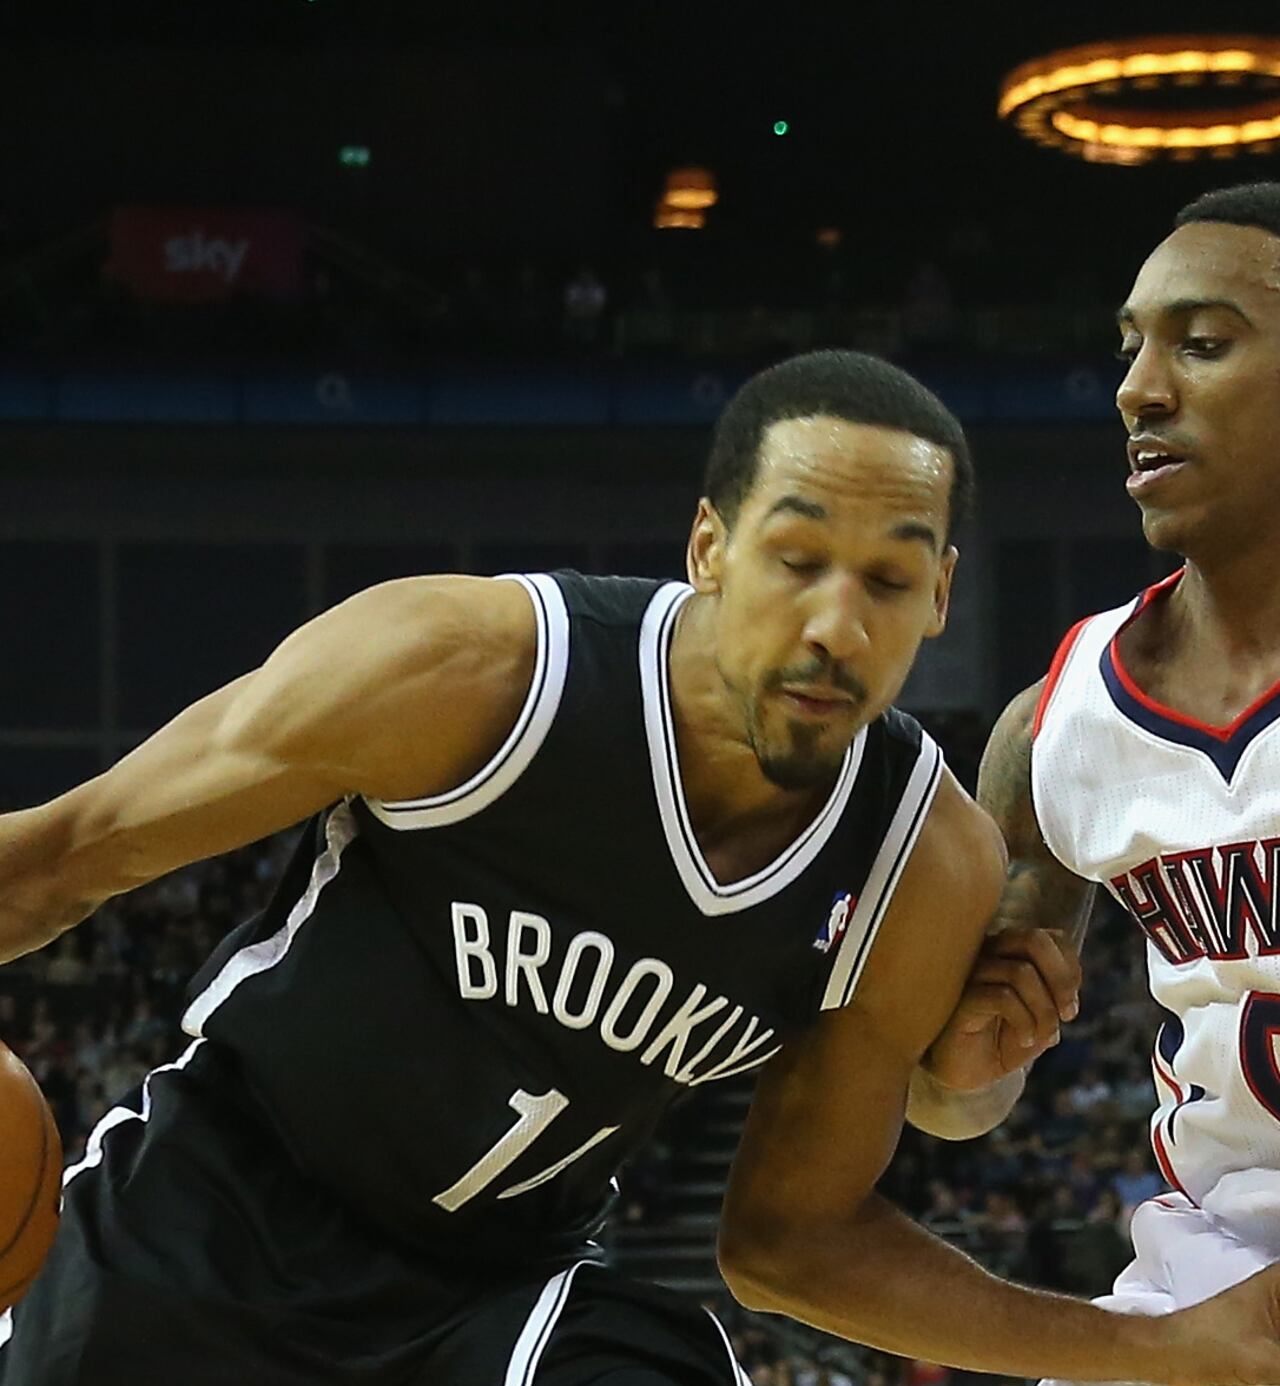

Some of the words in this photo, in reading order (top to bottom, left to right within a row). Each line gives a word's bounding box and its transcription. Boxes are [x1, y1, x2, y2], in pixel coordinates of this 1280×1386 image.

[165, 230, 249, 282] sky
[450, 900, 784, 1087] BROOKLY
[431, 1087, 621, 1213] 1
